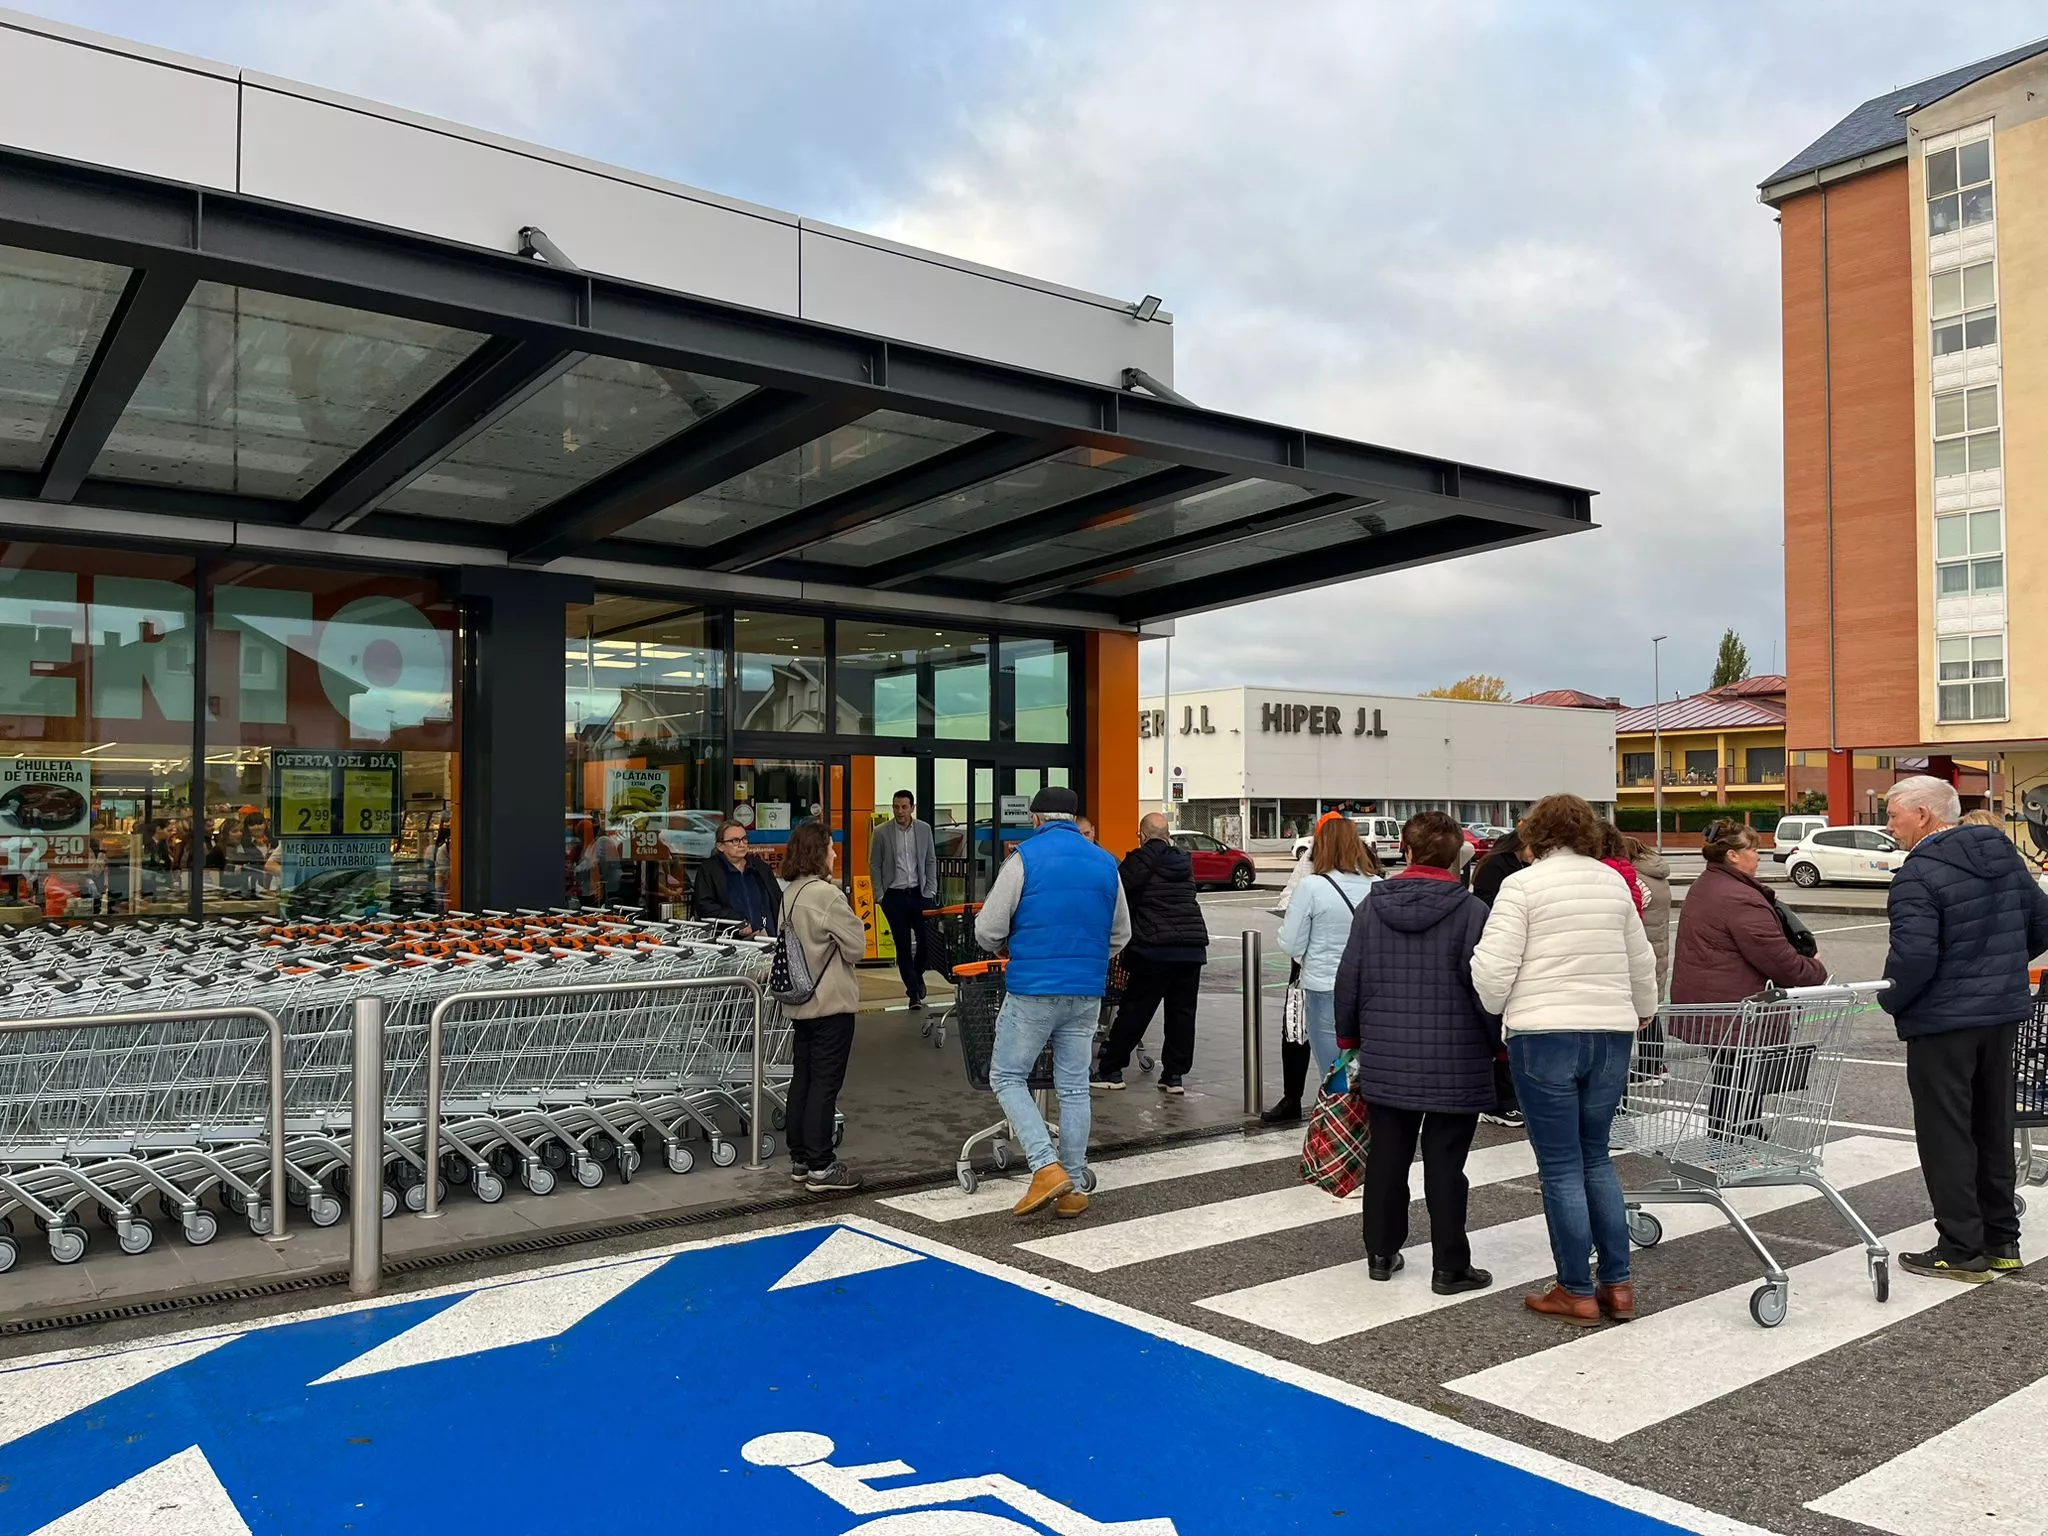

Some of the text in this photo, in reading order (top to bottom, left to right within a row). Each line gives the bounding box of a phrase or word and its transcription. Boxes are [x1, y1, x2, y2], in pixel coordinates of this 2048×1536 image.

[1180, 705, 1215, 735] J.L
[1262, 702, 1388, 737] HIPER J.L
[16, 760, 72, 770] CHULETA
[276, 754, 397, 768] OFERTA DEL DÍA
[4, 771, 83, 782] DE TERNERA
[286, 842, 386, 854] MERLUZA DE ANZUELO
[299, 857, 316, 867] DEL
